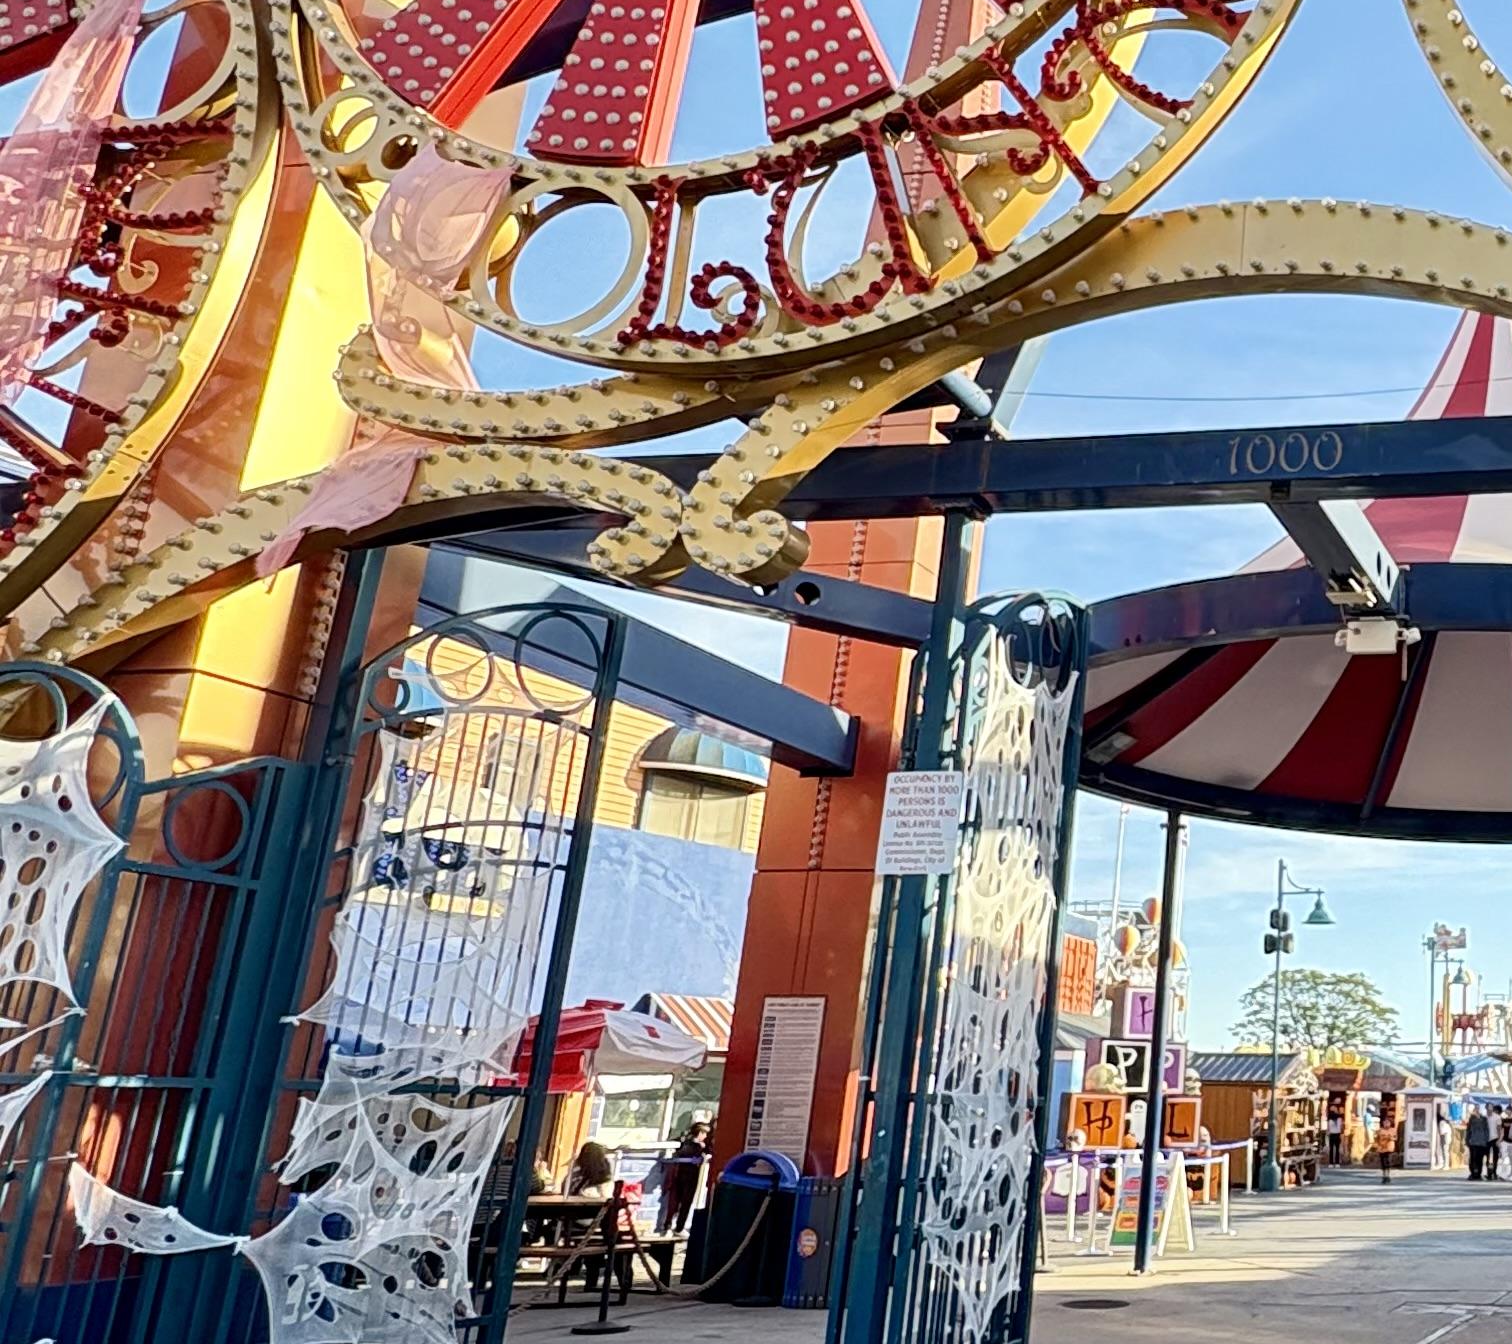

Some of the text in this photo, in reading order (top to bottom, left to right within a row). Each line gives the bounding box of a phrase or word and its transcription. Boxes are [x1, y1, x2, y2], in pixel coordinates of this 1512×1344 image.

[1229, 431, 1343, 475] 1000
[944, 774, 956, 783] BY
[890, 786, 910, 794] MORE
[913, 786, 935, 794] THAN
[898, 796, 945, 805] PERSONS IS
[886, 808, 957, 817] DANGEROUS AND
[895, 819, 941, 828] UNLAWFUL
